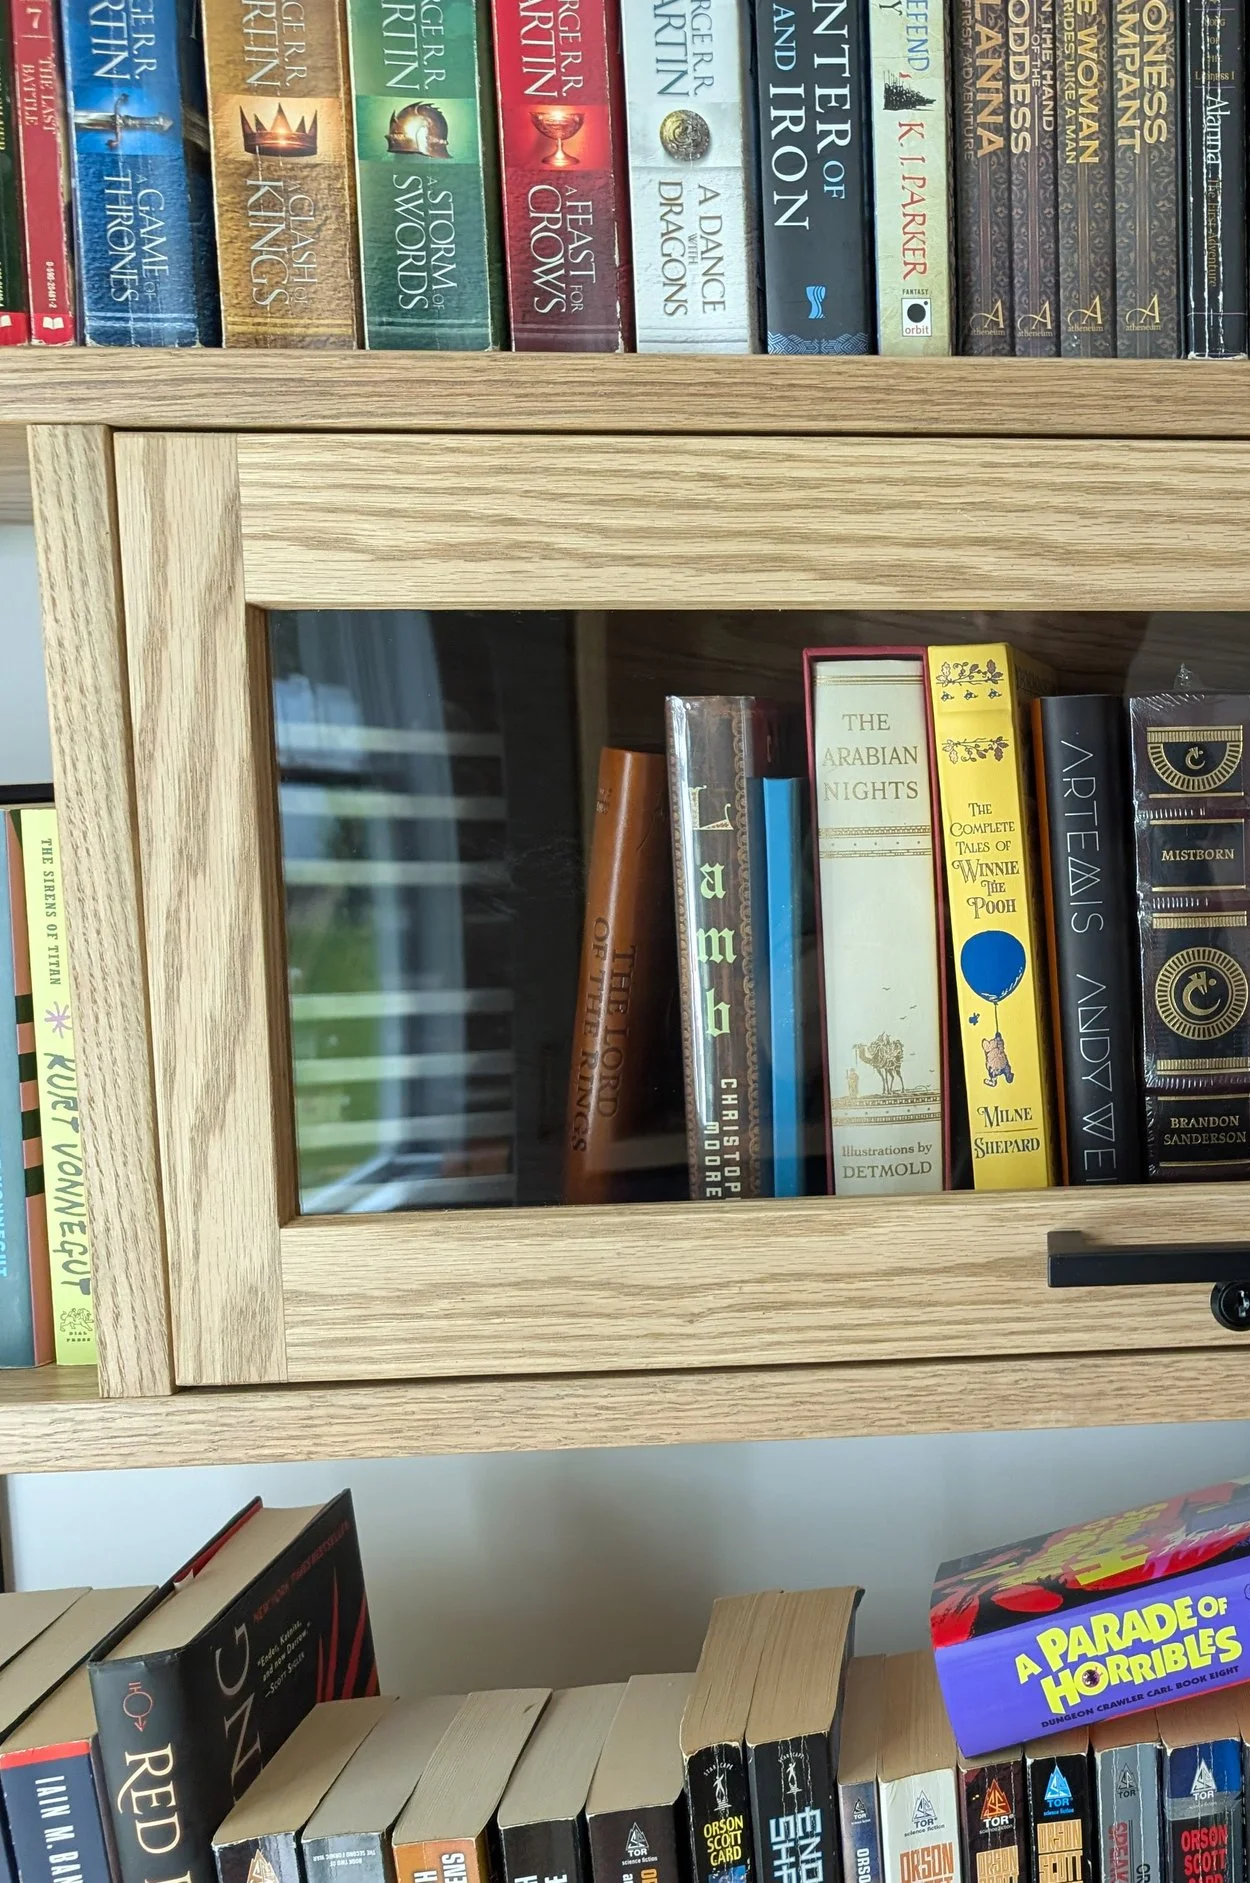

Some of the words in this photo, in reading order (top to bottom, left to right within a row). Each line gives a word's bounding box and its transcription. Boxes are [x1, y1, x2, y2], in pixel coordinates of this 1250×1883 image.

[773, 4, 796, 71] AND
[1078, 25, 1099, 163] WOMAN
[898, 121, 925, 148] K.
[770, 83, 809, 230] IRON
[136, 173, 146, 185] A
[288, 180, 299, 191] A
[426, 176, 437, 185] A
[564, 185, 576, 196] A
[698, 184, 721, 205] A
[137, 188, 170, 277] GAME
[288, 193, 317, 284] CLASH
[901, 173, 928, 280] PARKER
[103, 174, 139, 304] THRONES
[245, 178, 290, 309] KINGS
[392, 175, 429, 311] SWORDS
[427, 191, 457, 290] STORM
[527, 184, 566, 315] CROWS
[566, 199, 596, 283] FEAST
[658, 180, 688, 316] DRAGONS
[688, 233, 697, 265] WITH
[699, 215, 726, 314] DANCE
[143, 277, 157, 301] OF
[294, 286, 309, 305] OF
[570, 285, 585, 314] FOR
[432, 293, 445, 310] OF
[904, 323, 930, 336] orbit
[842, 713, 890, 731] THE
[822, 744, 918, 767] ARABIAN
[824, 780, 918, 801] NIGHTS
[968, 802, 992, 816] THE
[949, 822, 1015, 837] COMPLETE
[1060, 740, 1104, 935] ARTEMIS
[41, 839, 53, 864] THE
[955, 841, 991, 855] TALES
[996, 840, 1011, 851] OF
[1161, 848, 1235, 861] MISTBORN
[951, 860, 1019, 886] WINNIE
[43, 871, 56, 917] SIRENS
[981, 880, 1006, 897] THE
[967, 898, 1017, 919] POOH
[47, 924, 58, 939] OF
[48, 945, 61, 985] TITAN
[1076, 974, 1113, 1092] ANDY
[45, 1053, 81, 1135] KURT
[978, 1106, 1033, 1129] MILNE
[1170, 1116, 1239, 1128] BRANDON
[973, 1137, 1040, 1159] SHEPARD
[1163, 1131, 1247, 1145] SANDERSON
[841, 1143, 914, 1158] Illustrations
[918, 1143, 932, 1157] by
[843, 1160, 932, 1180] DETMOLD
[52, 1140, 92, 1297] VONNEGUT
[1014, 1653, 1042, 1685] A
[1036, 1595, 1197, 1666] PARADE
[1197, 1595, 1228, 1620] OF
[1040, 1626, 1243, 1715] HORRIBLES
[1040, 1707, 1095, 1730] DUNGEON
[1097, 1694, 1145, 1715] CRAWLER
[1147, 1685, 1174, 1703] CARL
[1176, 1676, 1205, 1692] BOOK
[1207, 1665, 1240, 1684] EIGHT
[117, 1742, 181, 1855] RED
[704, 1815, 744, 1838] ORSON
[904, 1828, 925, 1837] science
[707, 1831, 741, 1852] SCOTT
[710, 1844, 741, 1864] CARD
